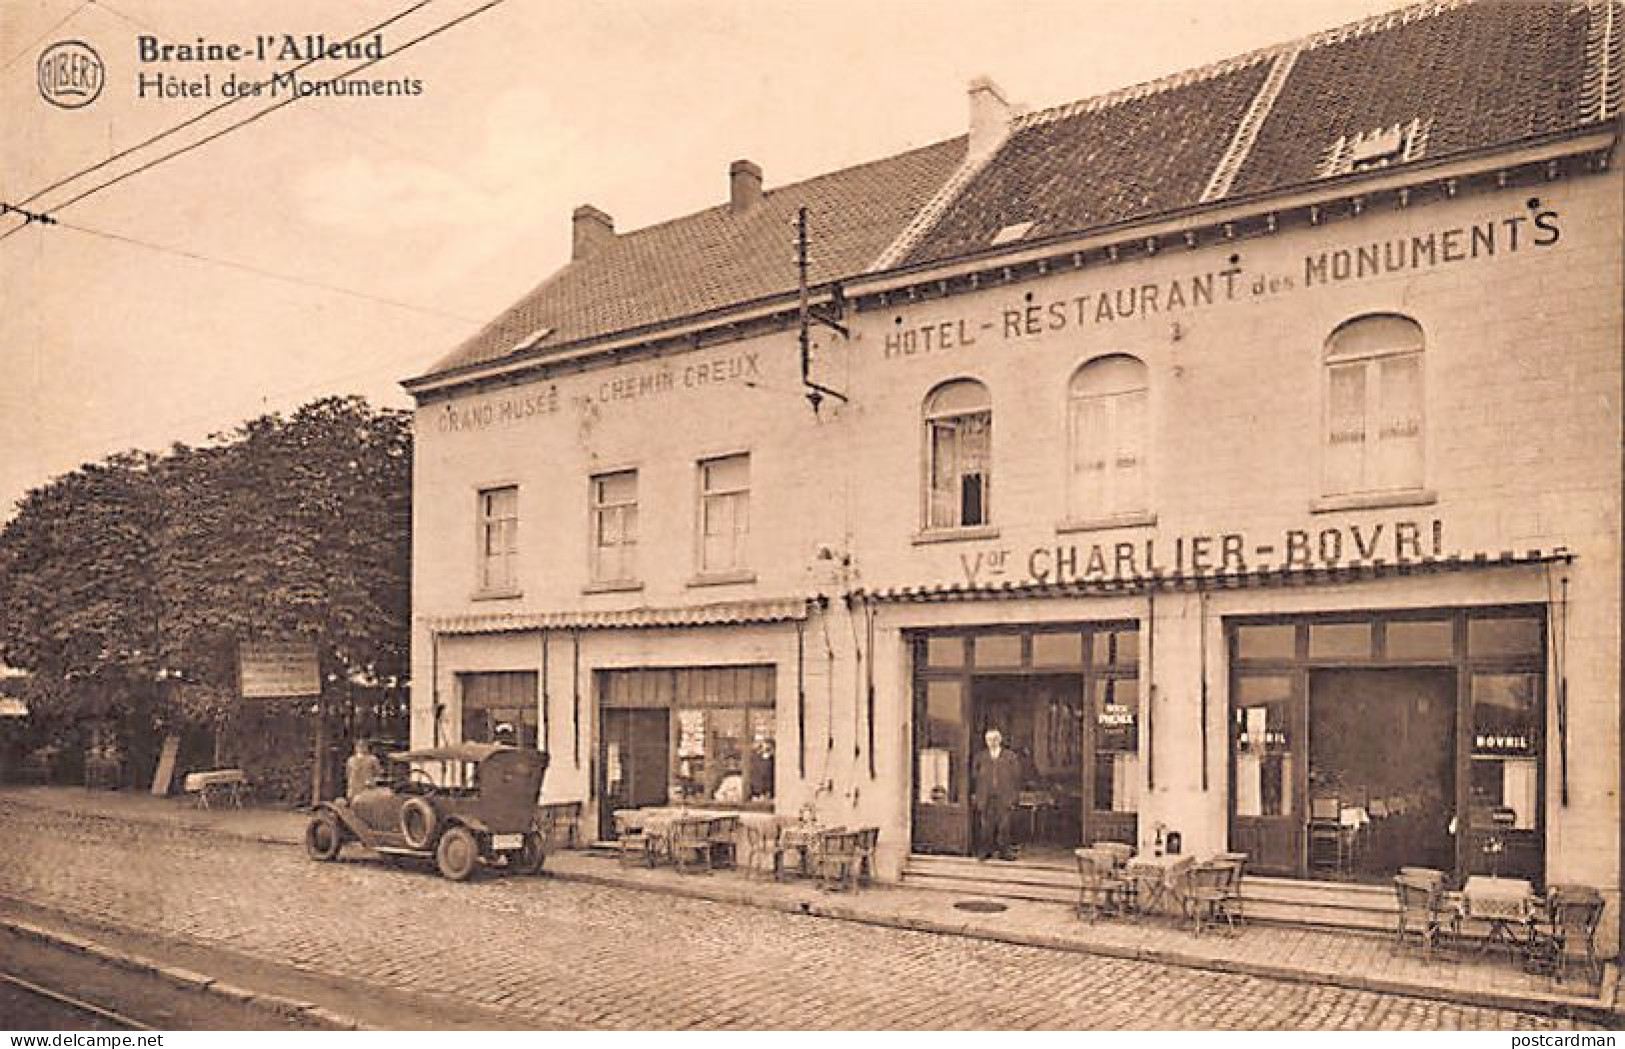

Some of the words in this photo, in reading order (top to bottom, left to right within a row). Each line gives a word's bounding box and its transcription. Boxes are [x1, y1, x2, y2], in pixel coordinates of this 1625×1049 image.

[1252, 274, 1295, 296] des
[1305, 211, 1560, 288] MONUMENTS
[438, 404, 492, 432] GRAND
[599, 370, 674, 402] CHEMIN
[684, 353, 759, 387] CREUX
[1476, 735, 1527, 748] BOVRIL
